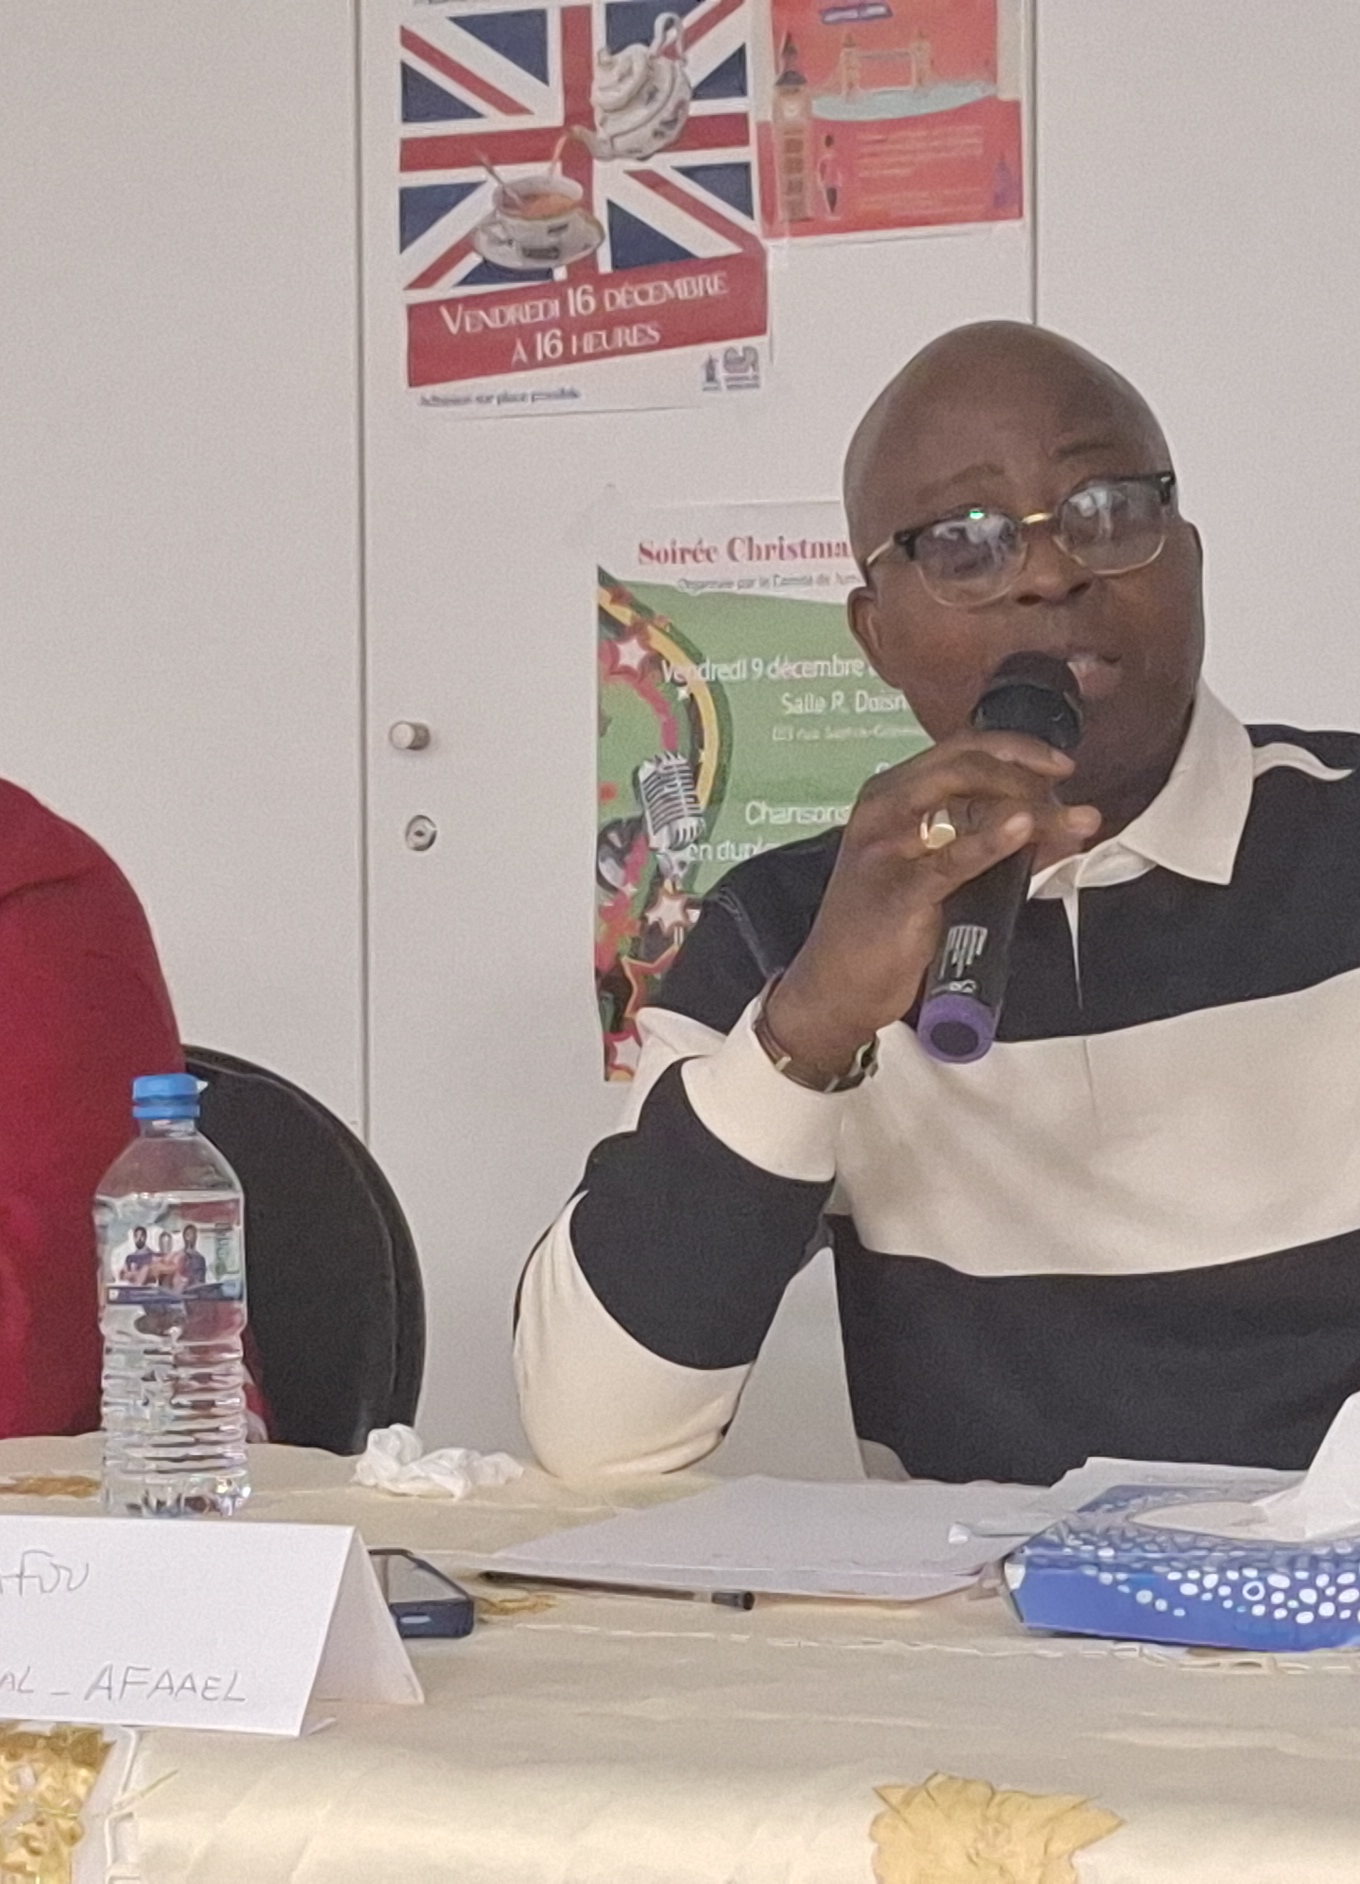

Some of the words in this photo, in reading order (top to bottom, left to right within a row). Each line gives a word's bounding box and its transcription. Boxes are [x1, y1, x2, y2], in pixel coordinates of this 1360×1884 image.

[439, 299, 561, 335] VENDREDI
[567, 285, 596, 317] 16
[603, 271, 728, 313] DÉCEMBRE
[536, 329, 564, 361] 16
[571, 322, 662, 356] HEURES
[638, 537, 718, 565] Soirée
[727, 535, 850, 563] Christma
[661, 656, 747, 683] Vendredi
[751, 657, 764, 680] 9
[767, 653, 864, 679] décembre
[781, 691, 826, 715] Salle
[855, 690, 908, 713] Doisn
[84, 1662, 247, 1702] AFAAEL
